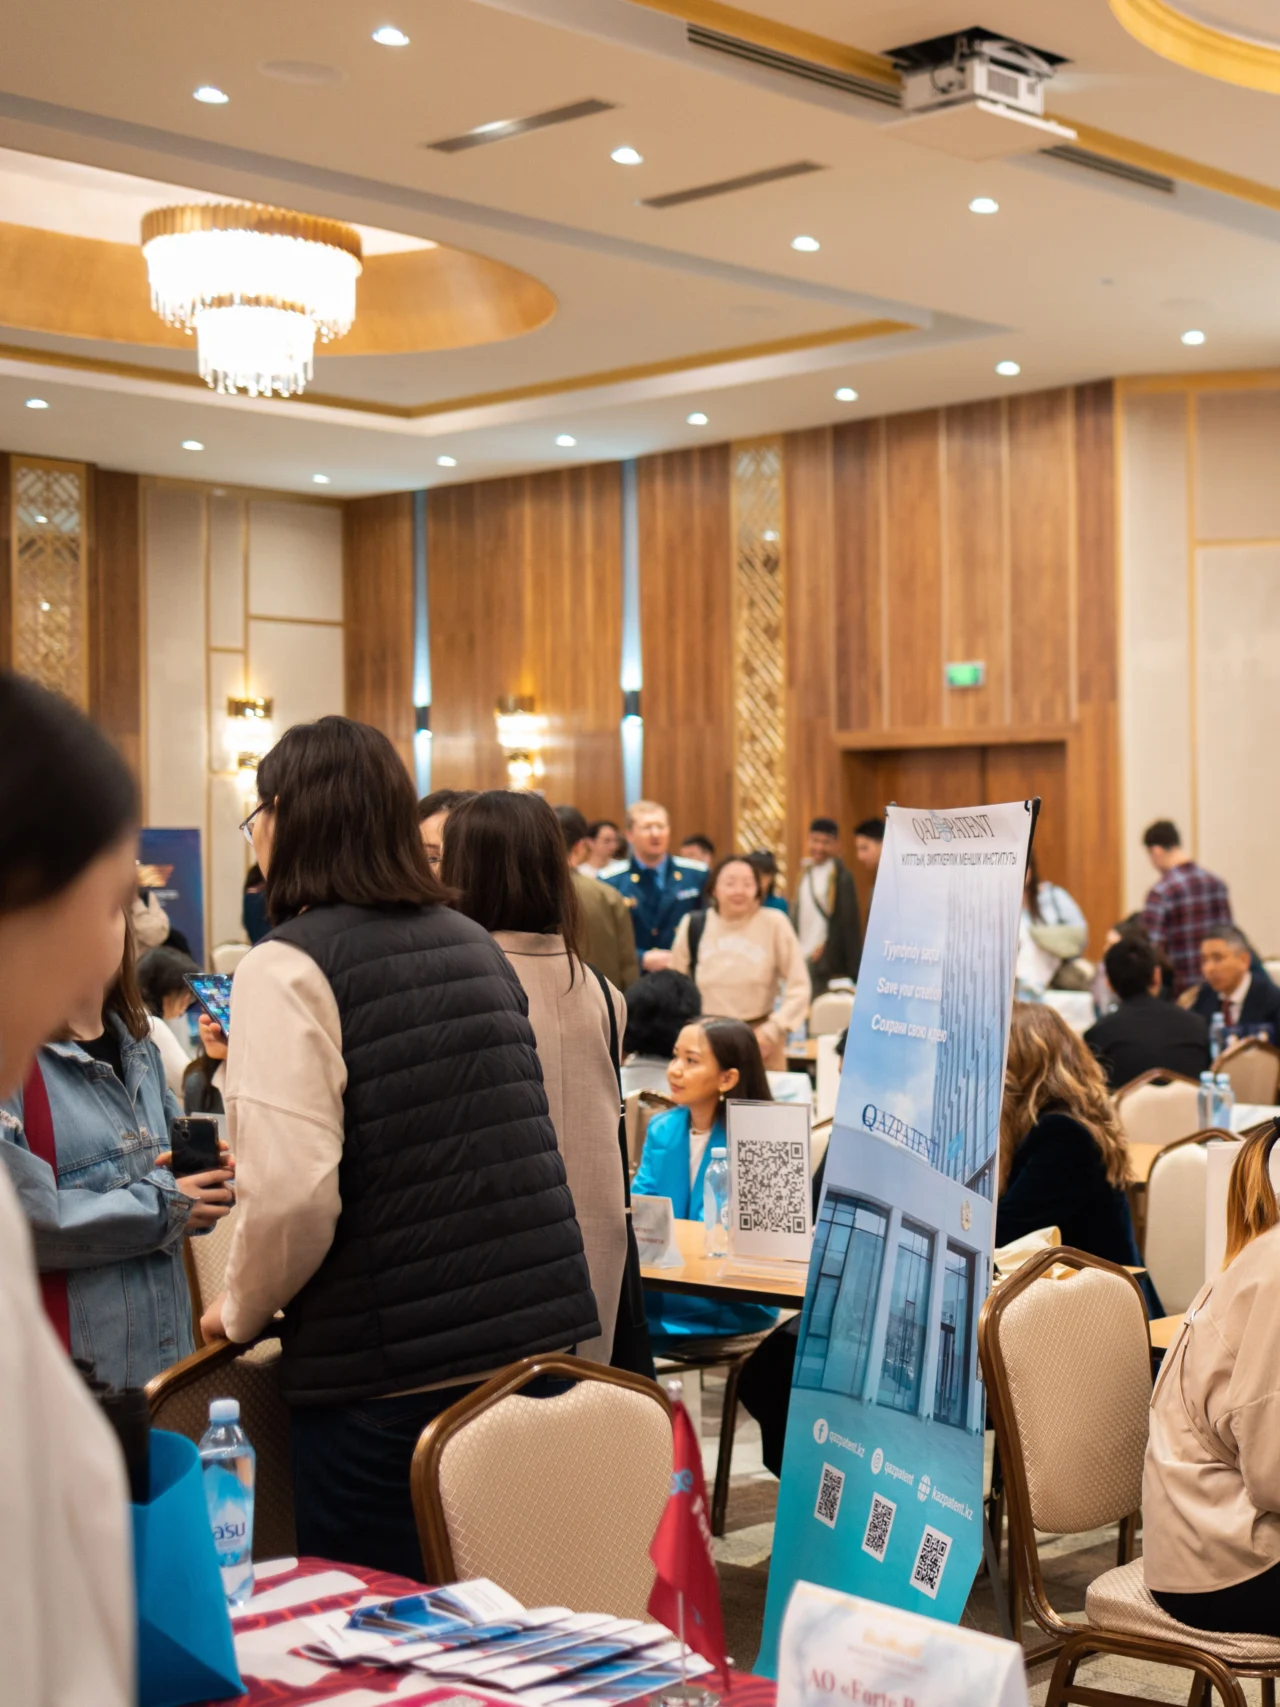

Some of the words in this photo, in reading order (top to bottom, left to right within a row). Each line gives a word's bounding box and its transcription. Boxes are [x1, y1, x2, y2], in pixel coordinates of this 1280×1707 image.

[877, 977, 898, 995] Save
[898, 984, 914, 1000] your
[871, 1014, 907, 1036] Сохрани
[829, 1431, 865, 1458] qazpatent.kz
[884, 1462, 915, 1486] qazpatent
[932, 1486, 974, 1521] kazpatent.kz
